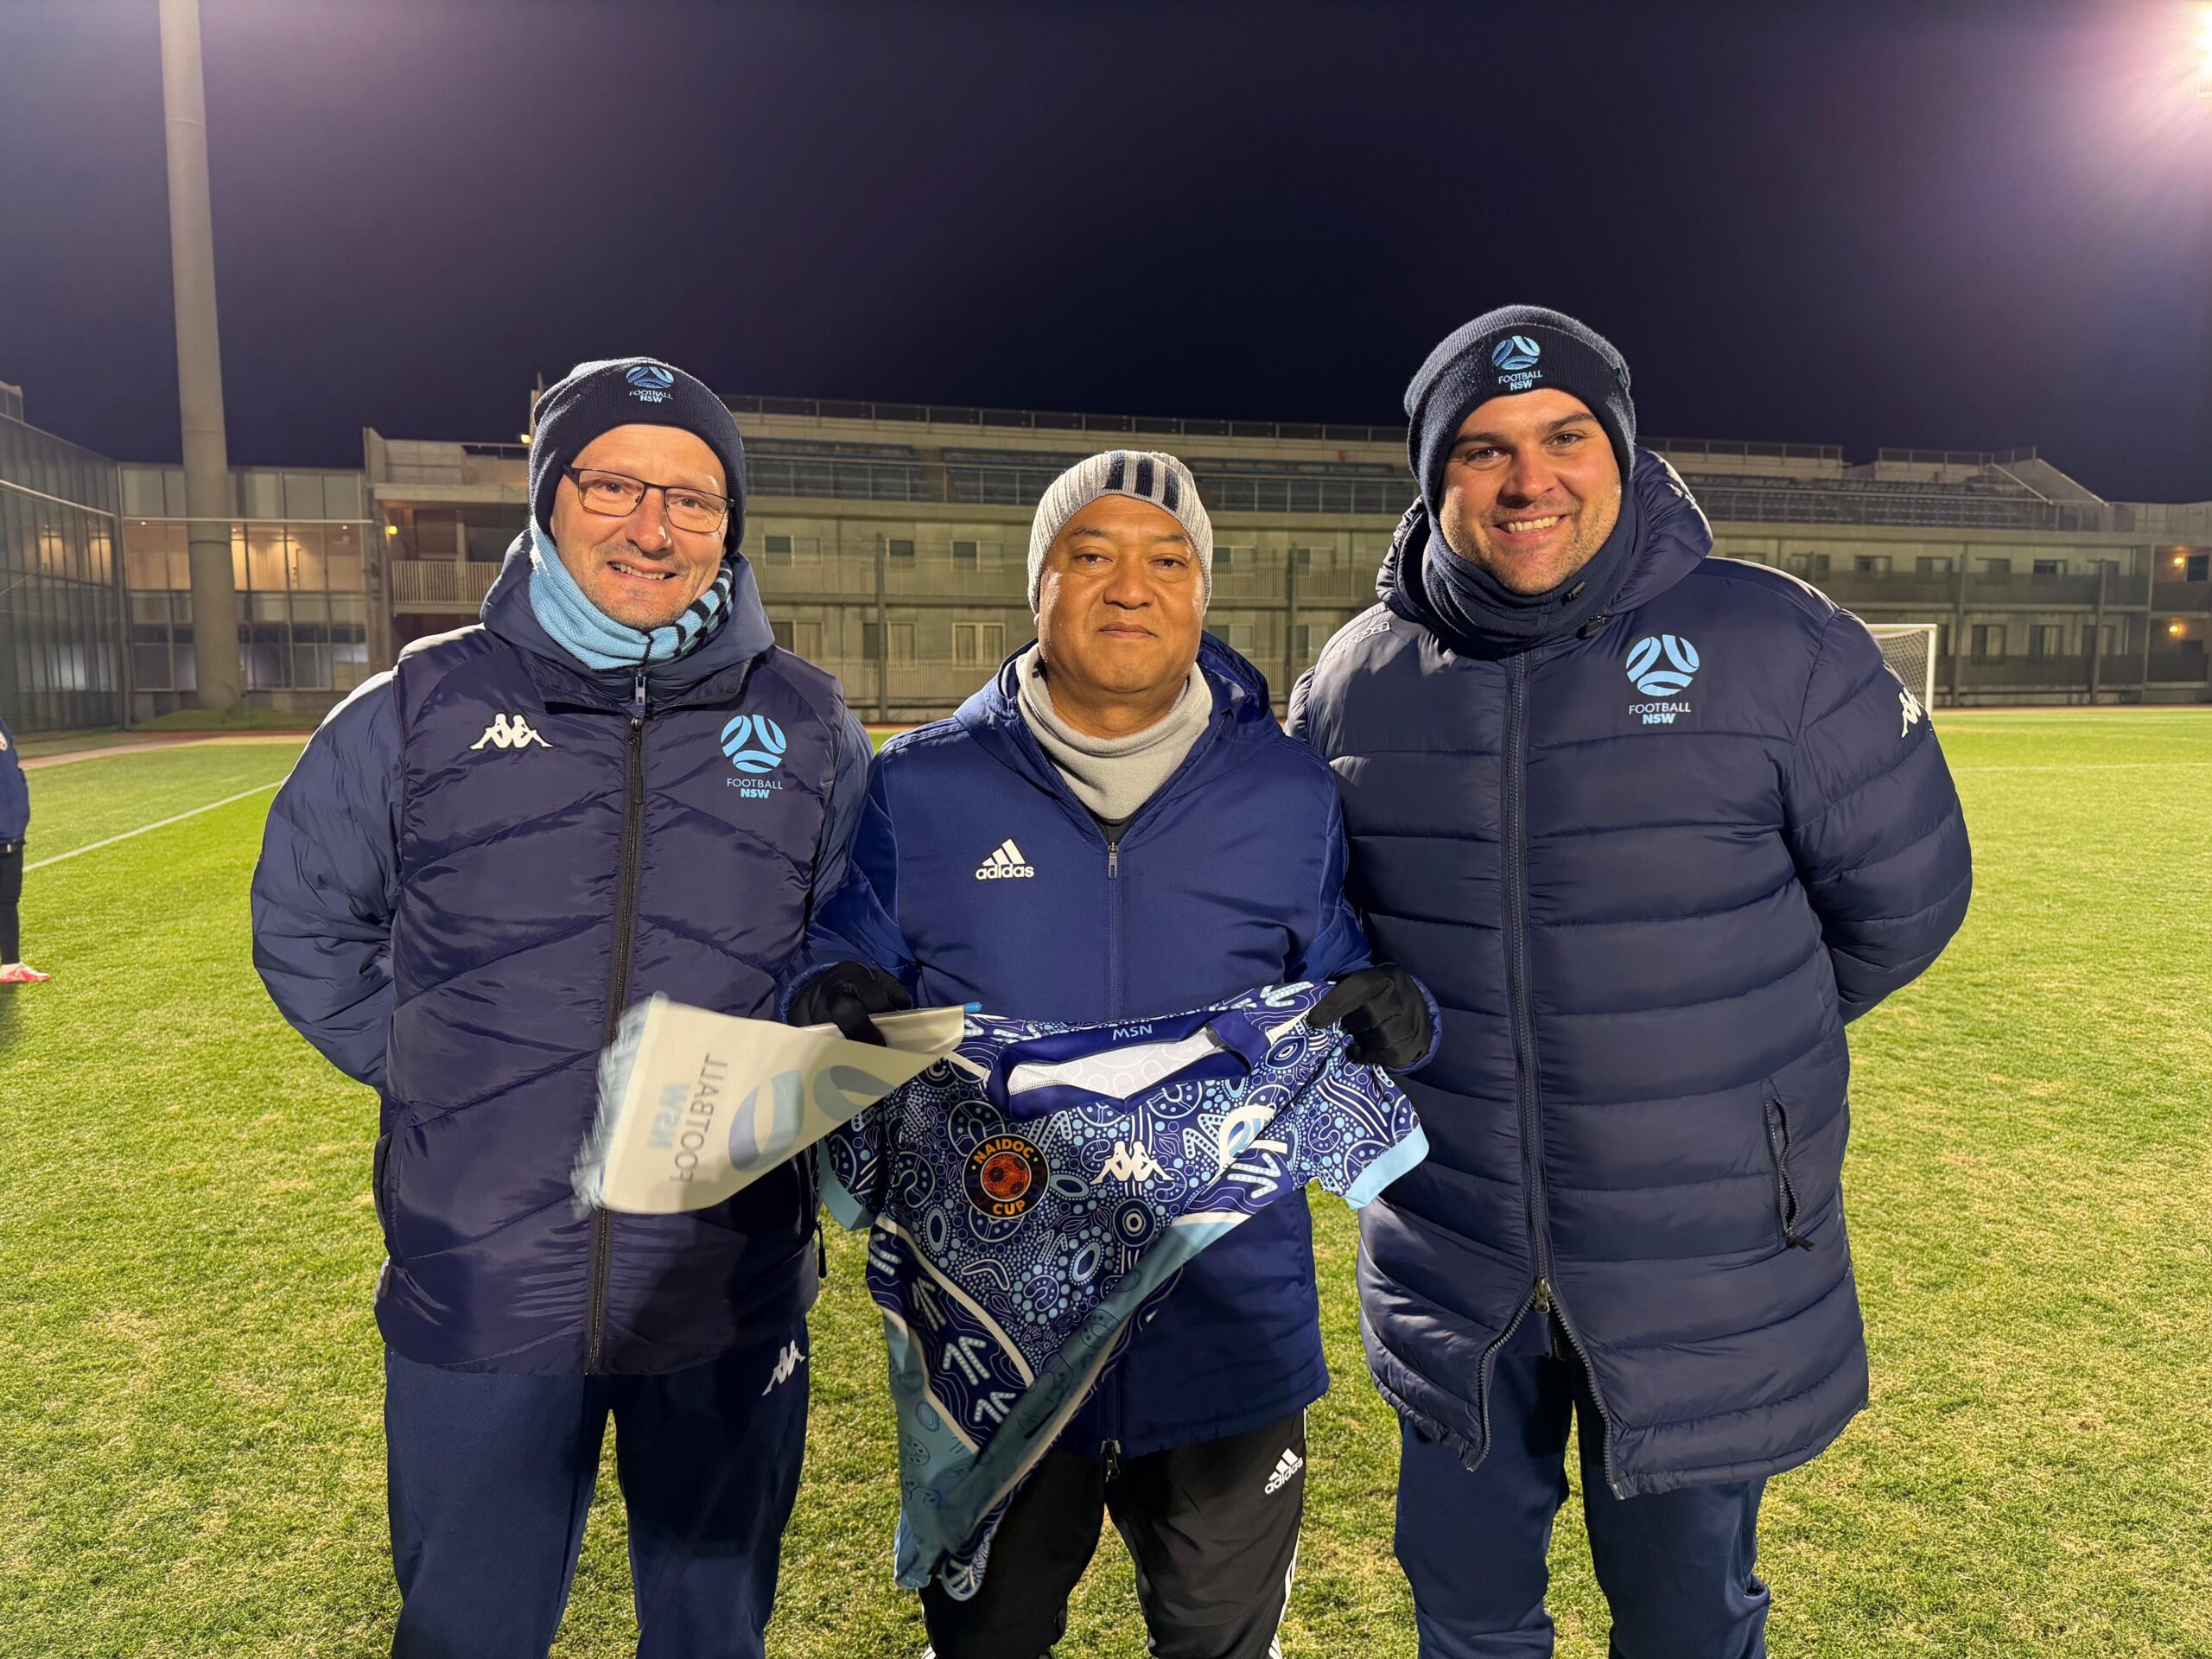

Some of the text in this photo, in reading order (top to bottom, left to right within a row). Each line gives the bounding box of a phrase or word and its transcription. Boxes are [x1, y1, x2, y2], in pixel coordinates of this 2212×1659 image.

[1498, 370, 1543, 385] FOOTBALL
[1510, 379, 1533, 391] NSW
[629, 390, 674, 400] FOOTBALL
[1629, 702, 1691, 715] FOOTBALL
[1643, 713, 1676, 724] NSW
[727, 778, 784, 790] FOOTBALL
[741, 788, 771, 798] NSW
[976, 863, 1035, 880] adidas
[973, 1138, 1035, 1165] NAIDOC
[993, 1199, 1026, 1215] CUP
[1264, 1457, 1304, 1494] adidas
